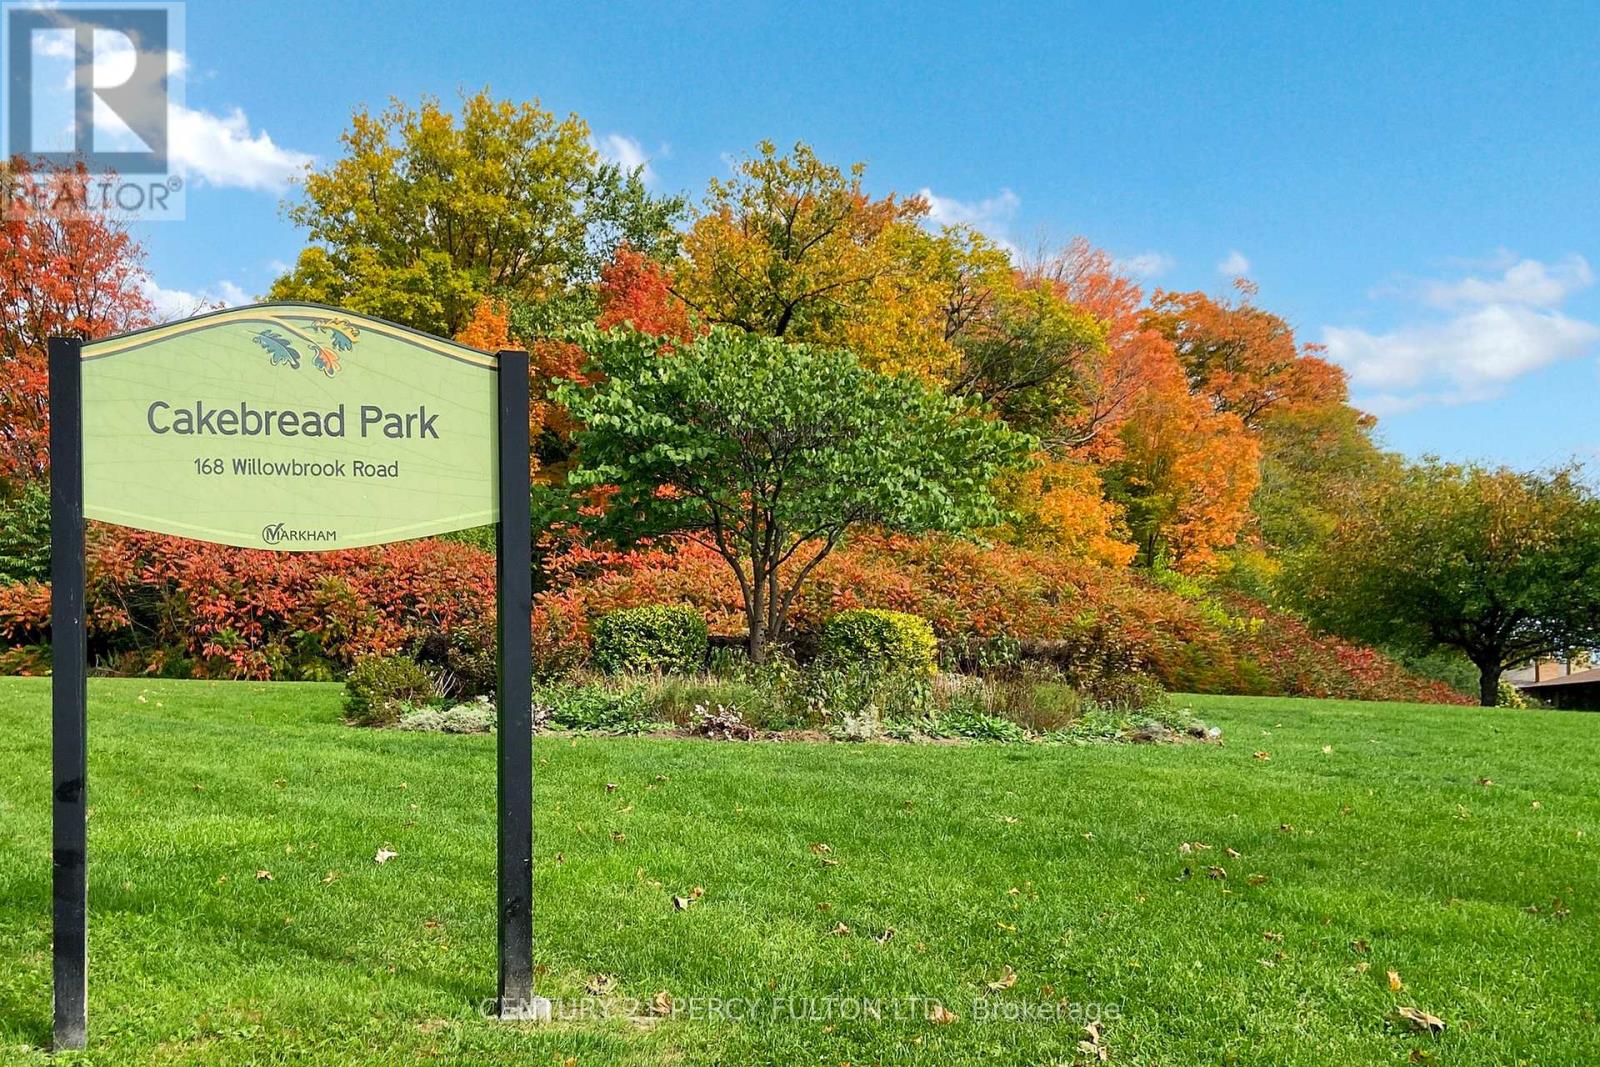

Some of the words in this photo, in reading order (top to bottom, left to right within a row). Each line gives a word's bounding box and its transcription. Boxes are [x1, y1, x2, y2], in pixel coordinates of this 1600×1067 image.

[147, 401, 345, 437] Cakebread
[360, 405, 440, 440] Park
[194, 458, 225, 475] 168
[232, 459, 346, 477] Willowbrook
[353, 461, 399, 478] Road
[262, 523, 337, 545] MARKHAM
